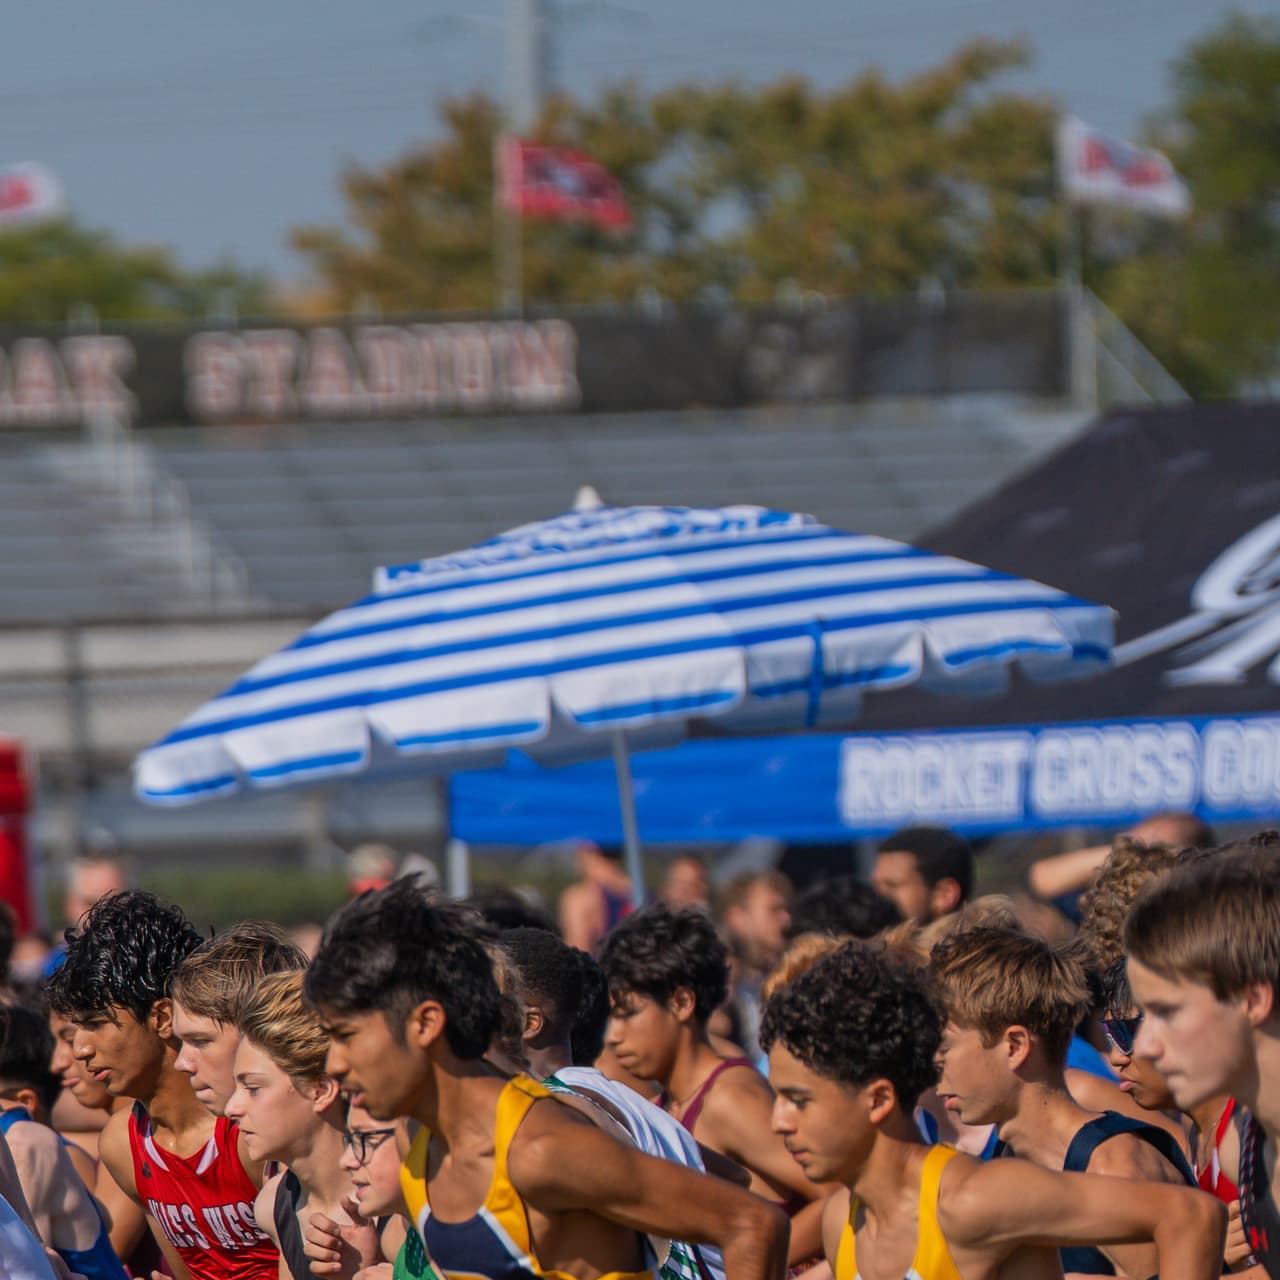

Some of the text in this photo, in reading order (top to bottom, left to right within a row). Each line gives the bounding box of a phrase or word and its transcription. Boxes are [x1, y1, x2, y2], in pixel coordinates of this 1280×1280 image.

[184, 319, 581, 420] STADIUM
[842, 733, 1034, 828] ROCKET
[1034, 722, 1200, 816] CROSS
[201, 1200, 271, 1250] WES
